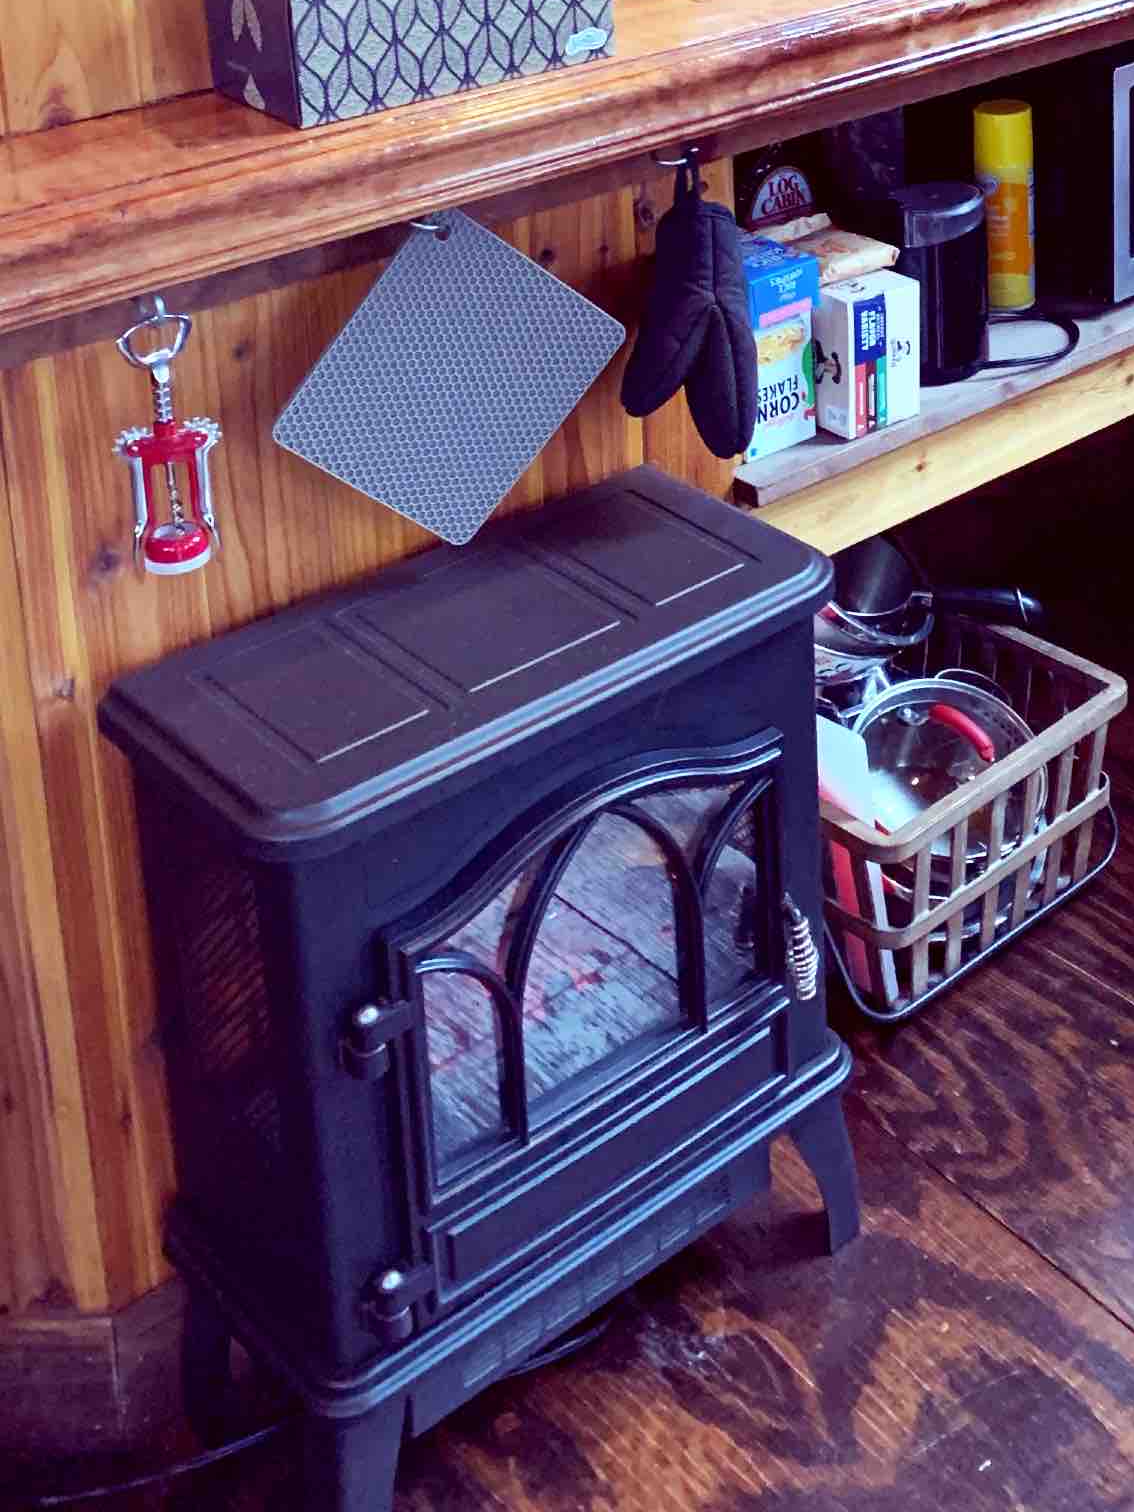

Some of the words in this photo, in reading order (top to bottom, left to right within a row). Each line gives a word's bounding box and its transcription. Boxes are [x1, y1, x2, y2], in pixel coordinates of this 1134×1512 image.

[767, 174, 801, 197] LOG
[761, 191, 806, 216] CABIN
[756, 374, 799, 402] FLAKES
[757, 391, 800, 425] CORN
